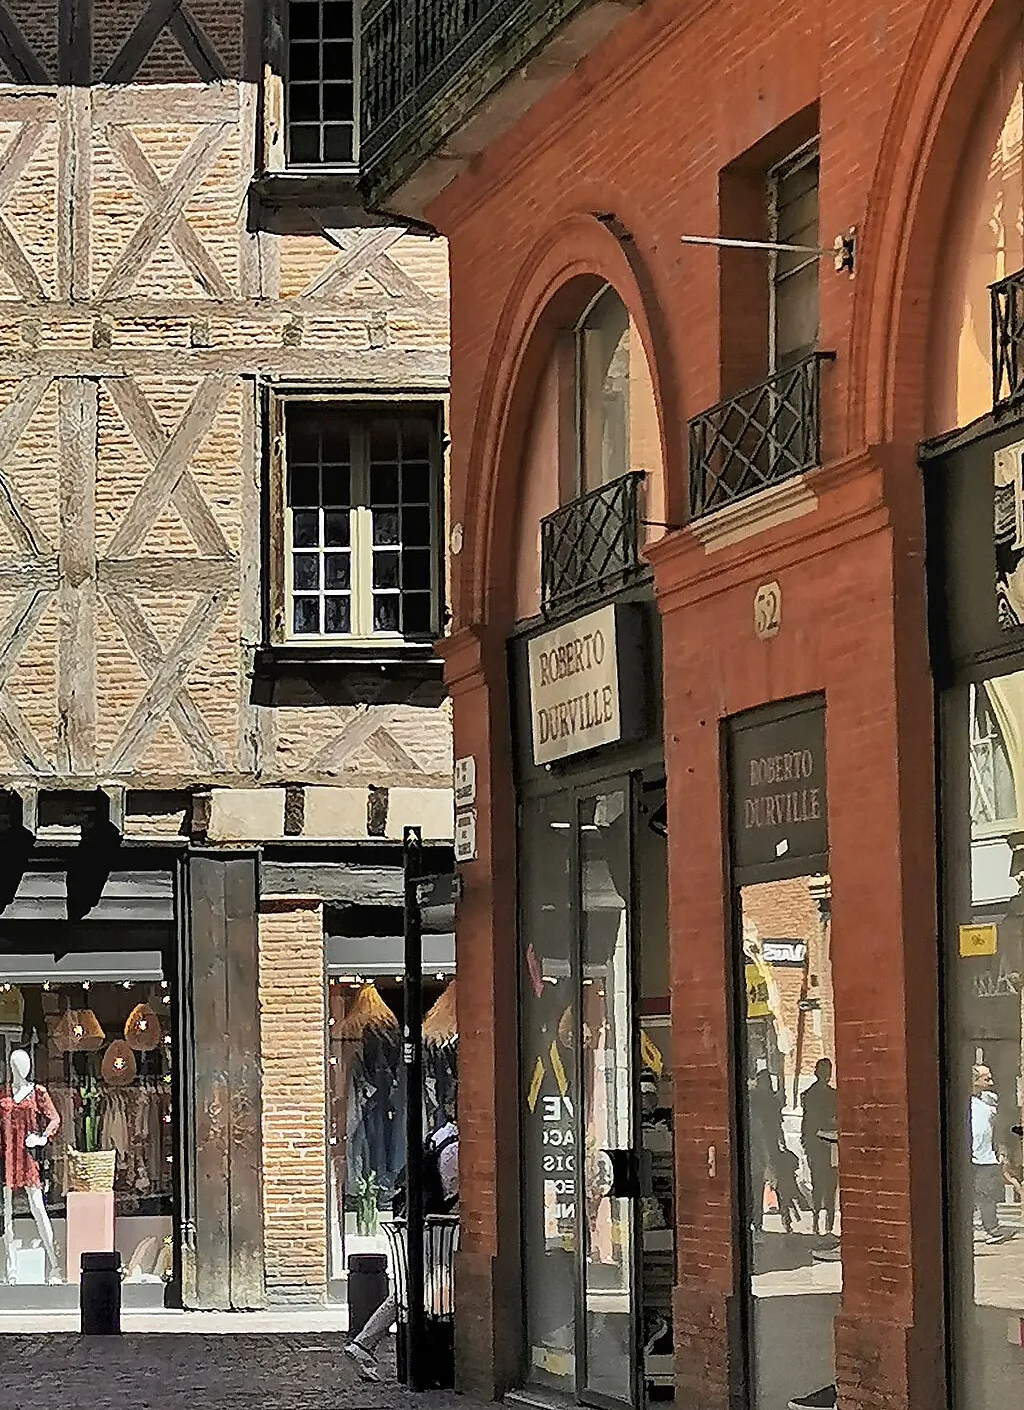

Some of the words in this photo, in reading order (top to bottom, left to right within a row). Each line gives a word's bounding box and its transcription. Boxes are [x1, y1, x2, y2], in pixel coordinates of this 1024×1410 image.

[756, 589, 779, 633] 52
[539, 630, 605, 687] ROBERTO
[538, 686, 613, 745] DURVILLE
[749, 748, 813, 787] ROBERTO
[744, 788, 820, 829] DURVILLE
